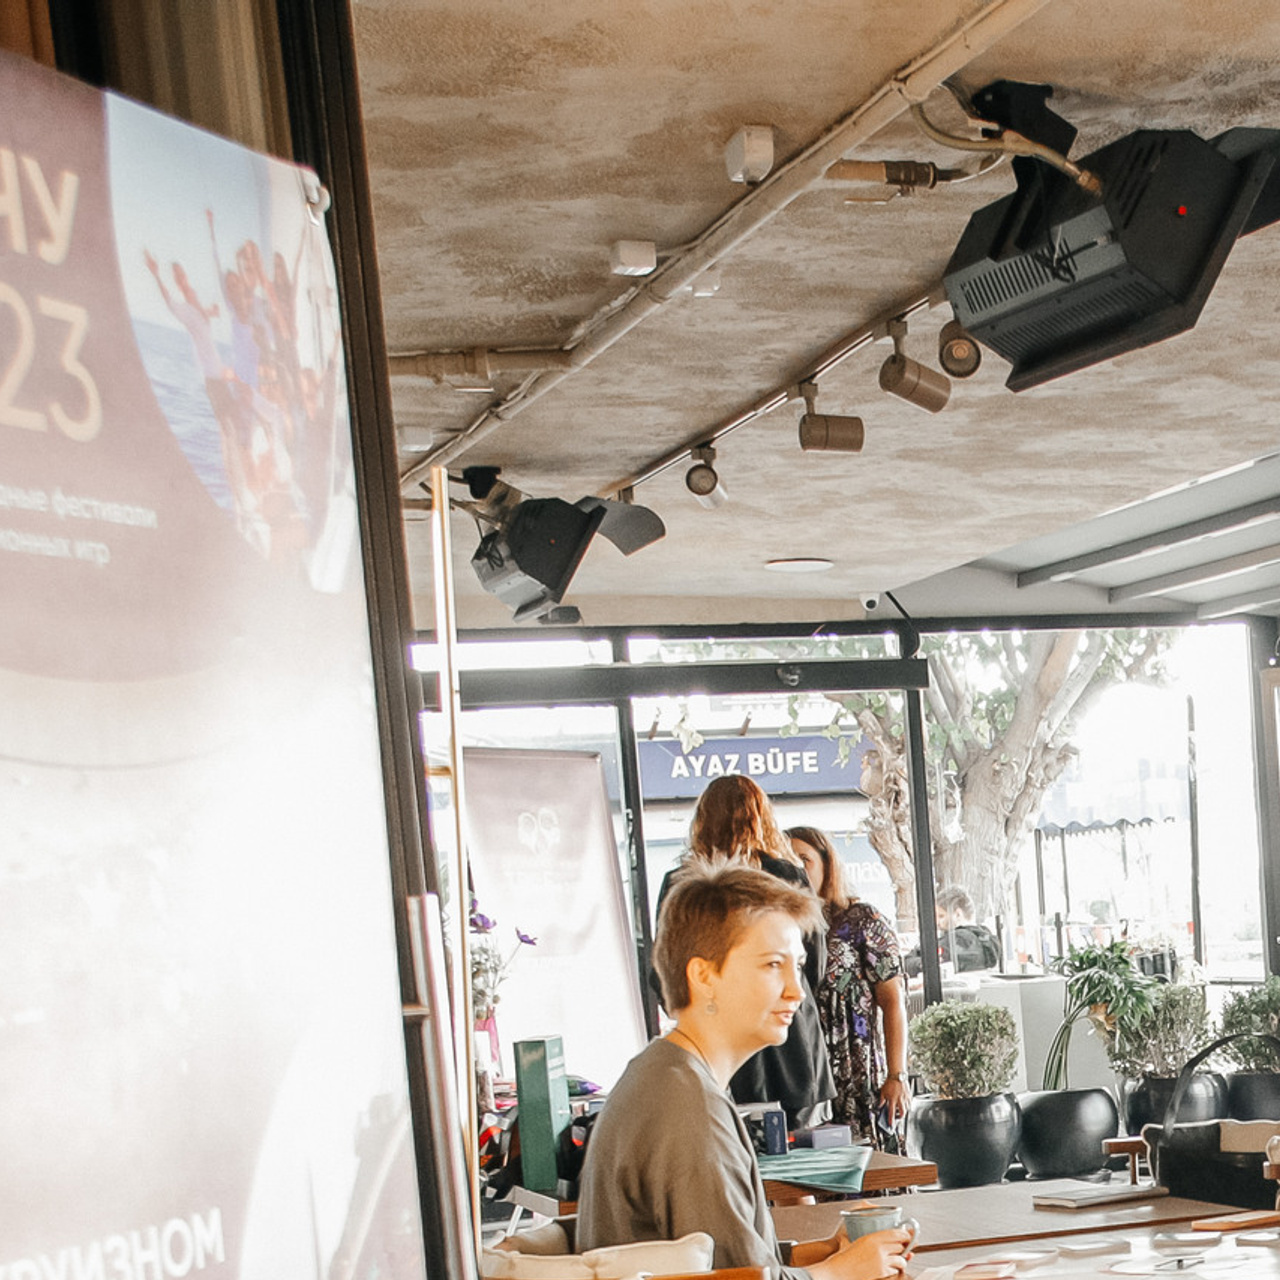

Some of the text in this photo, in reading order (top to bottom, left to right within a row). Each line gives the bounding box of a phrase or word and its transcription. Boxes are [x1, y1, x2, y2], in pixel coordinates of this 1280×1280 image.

[0, 283, 103, 443] 23
[671, 747, 819, 778] AYAZ BÜFE
